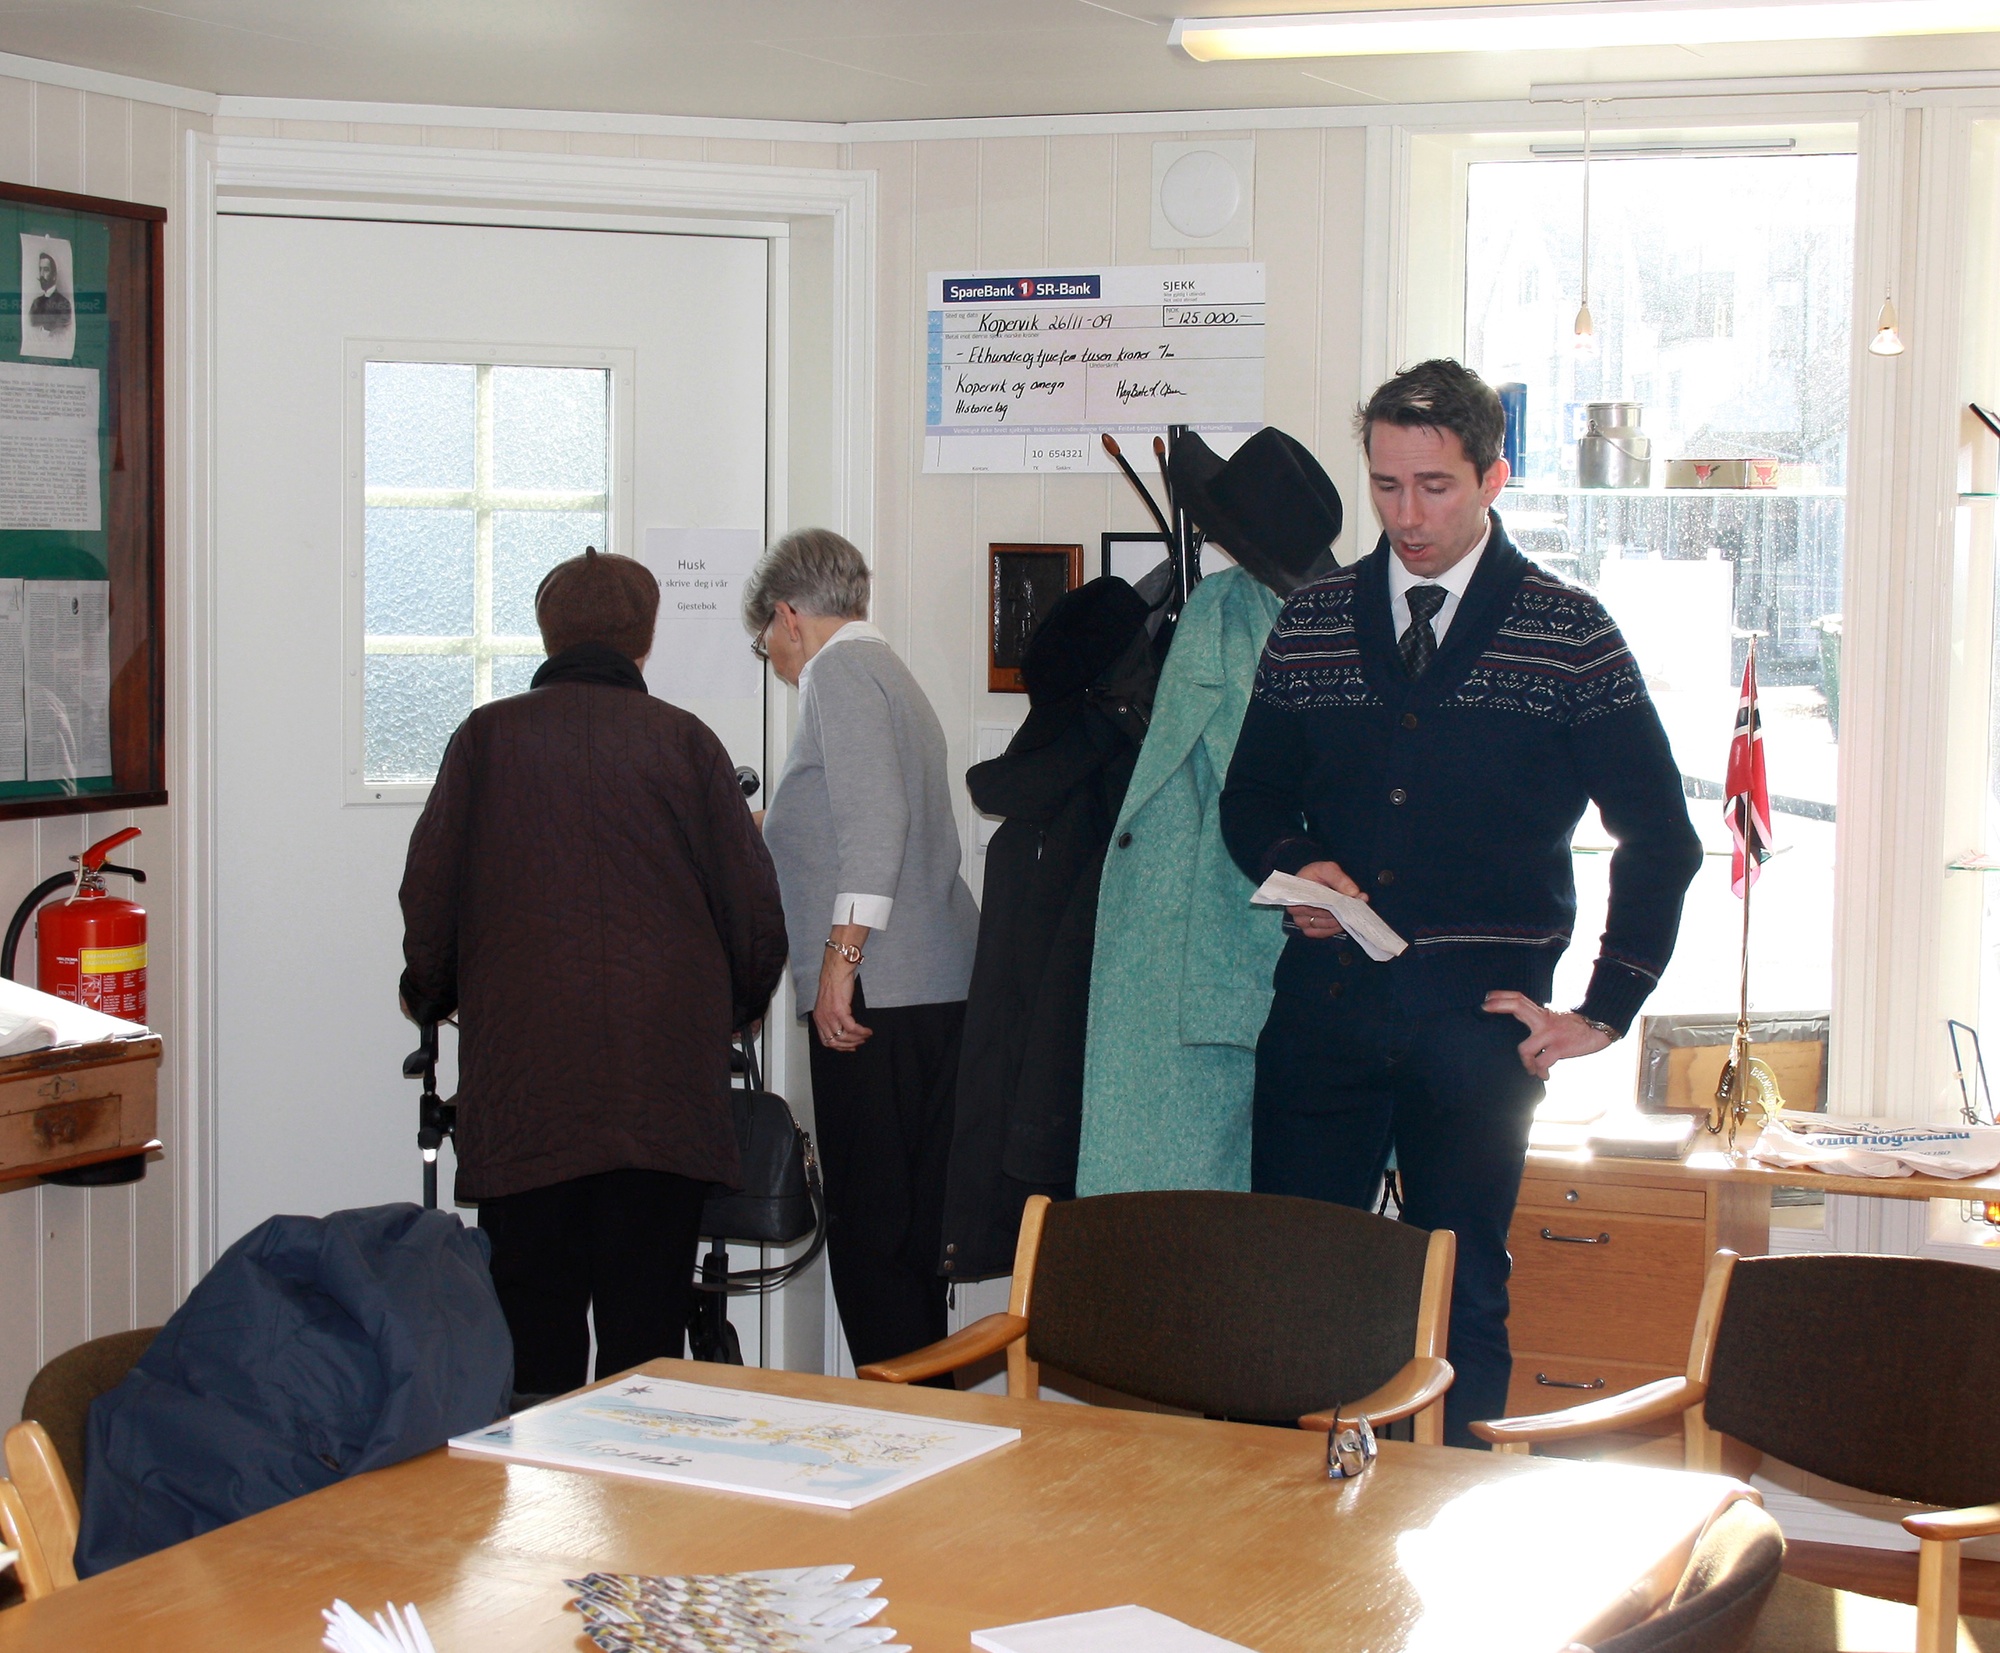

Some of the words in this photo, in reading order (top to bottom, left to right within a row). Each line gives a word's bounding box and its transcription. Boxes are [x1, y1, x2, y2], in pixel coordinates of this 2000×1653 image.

[950, 284, 1015, 300] SpareBank
[1037, 282, 1091, 296] SR-Bank
[1163, 280, 1196, 292] SJEKK
[979, 312, 1040, 337] Kopervik
[955, 373, 1007, 396] Kopervik
[1012, 381, 1026, 399] og
[1032, 449, 1045, 458] 10
[1048, 448, 1084, 458] 654321
[678, 559, 706, 571] Husk
[666, 579, 690, 587] skrive
[694, 578, 709, 589] deg
[715, 578, 728, 587] vår
[677, 601, 717, 612] Gjestebok
